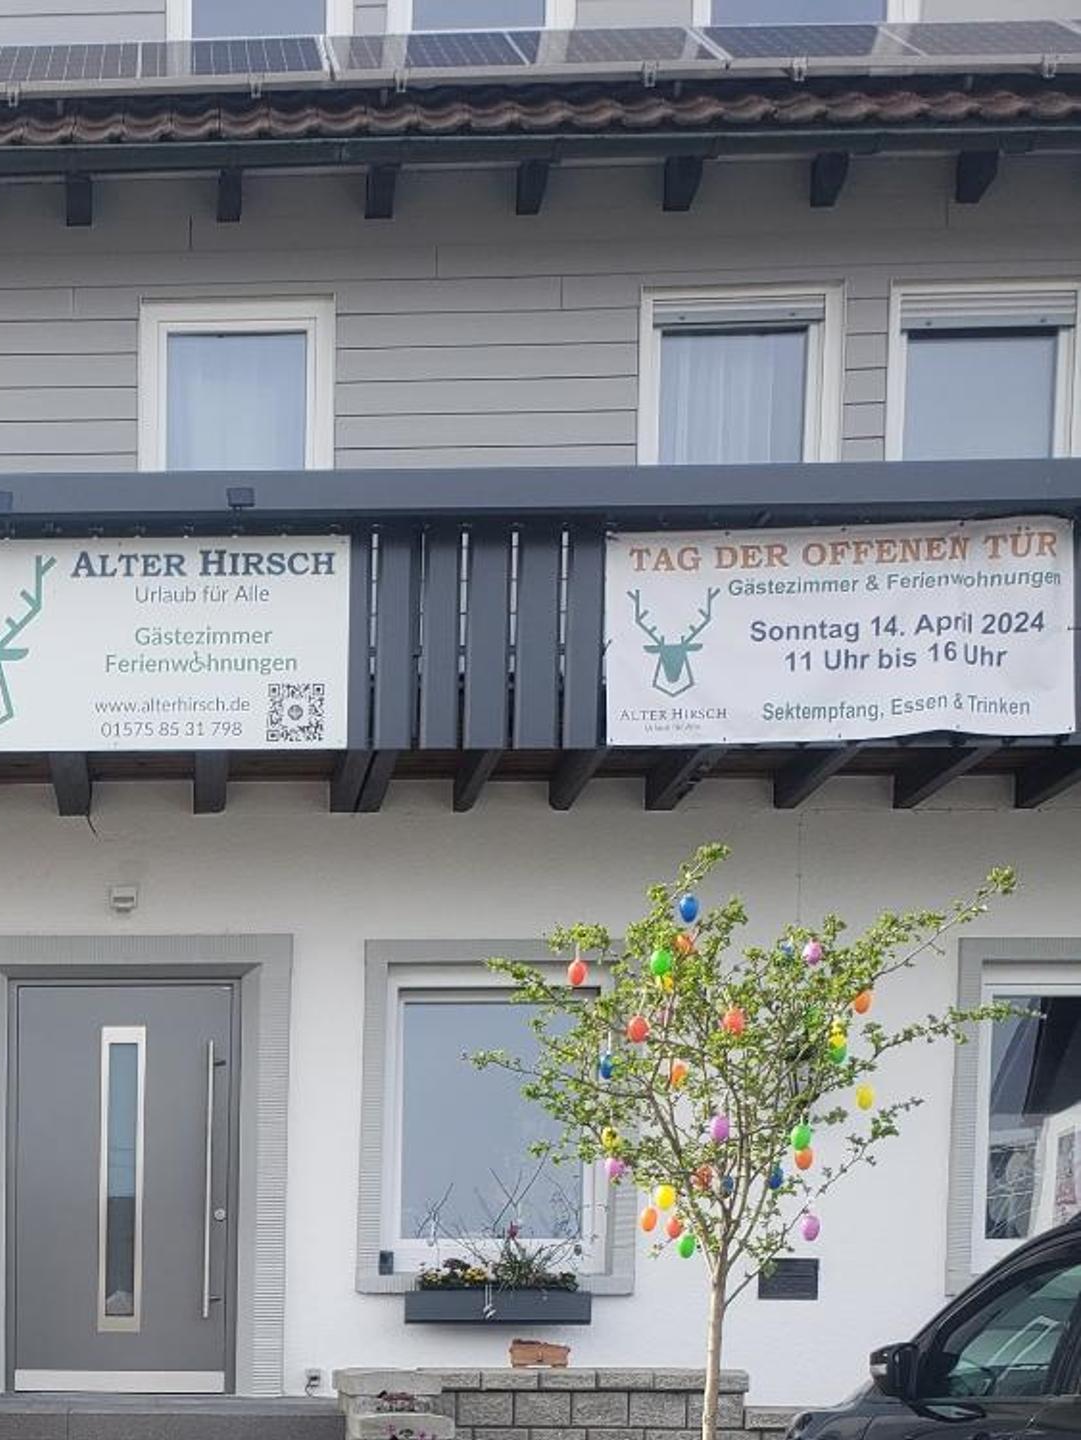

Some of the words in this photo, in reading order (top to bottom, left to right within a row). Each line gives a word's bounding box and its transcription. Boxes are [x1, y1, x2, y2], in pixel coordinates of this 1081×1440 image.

[629, 546, 702, 571] TAG
[715, 543, 789, 569] DER
[802, 536, 970, 567] OFFENEN
[984, 526, 1057, 560] TÜR
[135, 585, 196, 602] Urlaub
[203, 585, 229, 602] für
[235, 585, 270, 601] Alle
[728, 577, 858, 596] Gästezimmer
[865, 574, 879, 591] &
[887, 571, 1061, 589] Ferienwohnungen
[135, 626, 273, 645] Gästezimmer
[750, 620, 860, 643] Sonntag
[871, 616, 905, 637] 14.
[914, 612, 973, 636] April
[981, 611, 1044, 635] 2024
[105, 651, 297, 675] Ferienwohnungen
[785, 651, 812, 672] 11
[824, 650, 869, 670] Uhr
[878, 648, 917, 670] bis
[928, 641, 957, 662] 16
[963, 644, 1008, 667] Uhr
[95, 698, 251, 713] www.alterhirsch.de
[763, 702, 885, 723] Sektempfang,
[891, 694, 948, 716] Essen
[953, 692, 964, 709] &
[969, 695, 1030, 716] Trinken
[101, 722, 154, 738] 01575
[158, 721, 179, 737] 85
[184, 721, 204, 737] 31
[211, 721, 243, 737] 798
